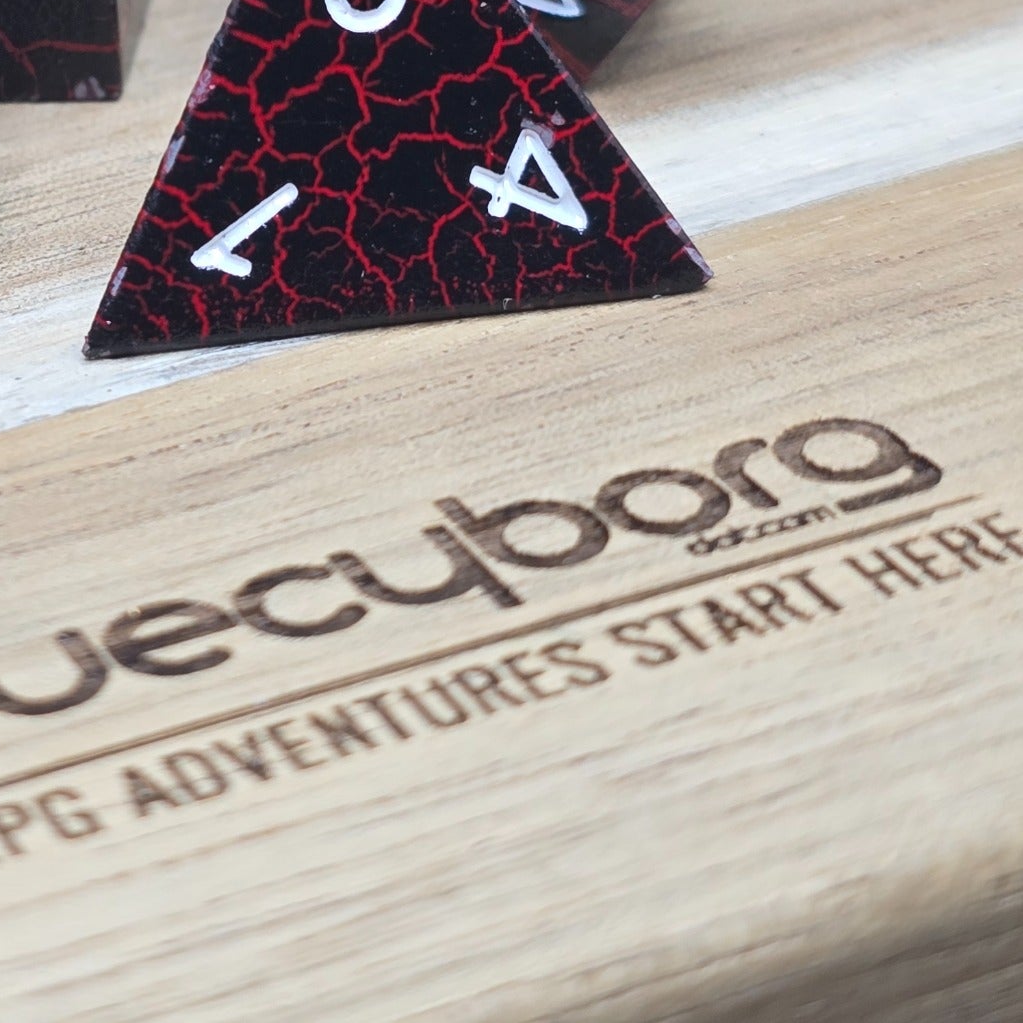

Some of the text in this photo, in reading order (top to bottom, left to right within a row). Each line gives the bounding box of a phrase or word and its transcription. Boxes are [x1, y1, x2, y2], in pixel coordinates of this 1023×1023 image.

[190, 182, 299, 277] 1
[469, 128, 588, 231] 4
[121, 640, 613, 819] ADVENTURES
[609, 566, 847, 667] START
